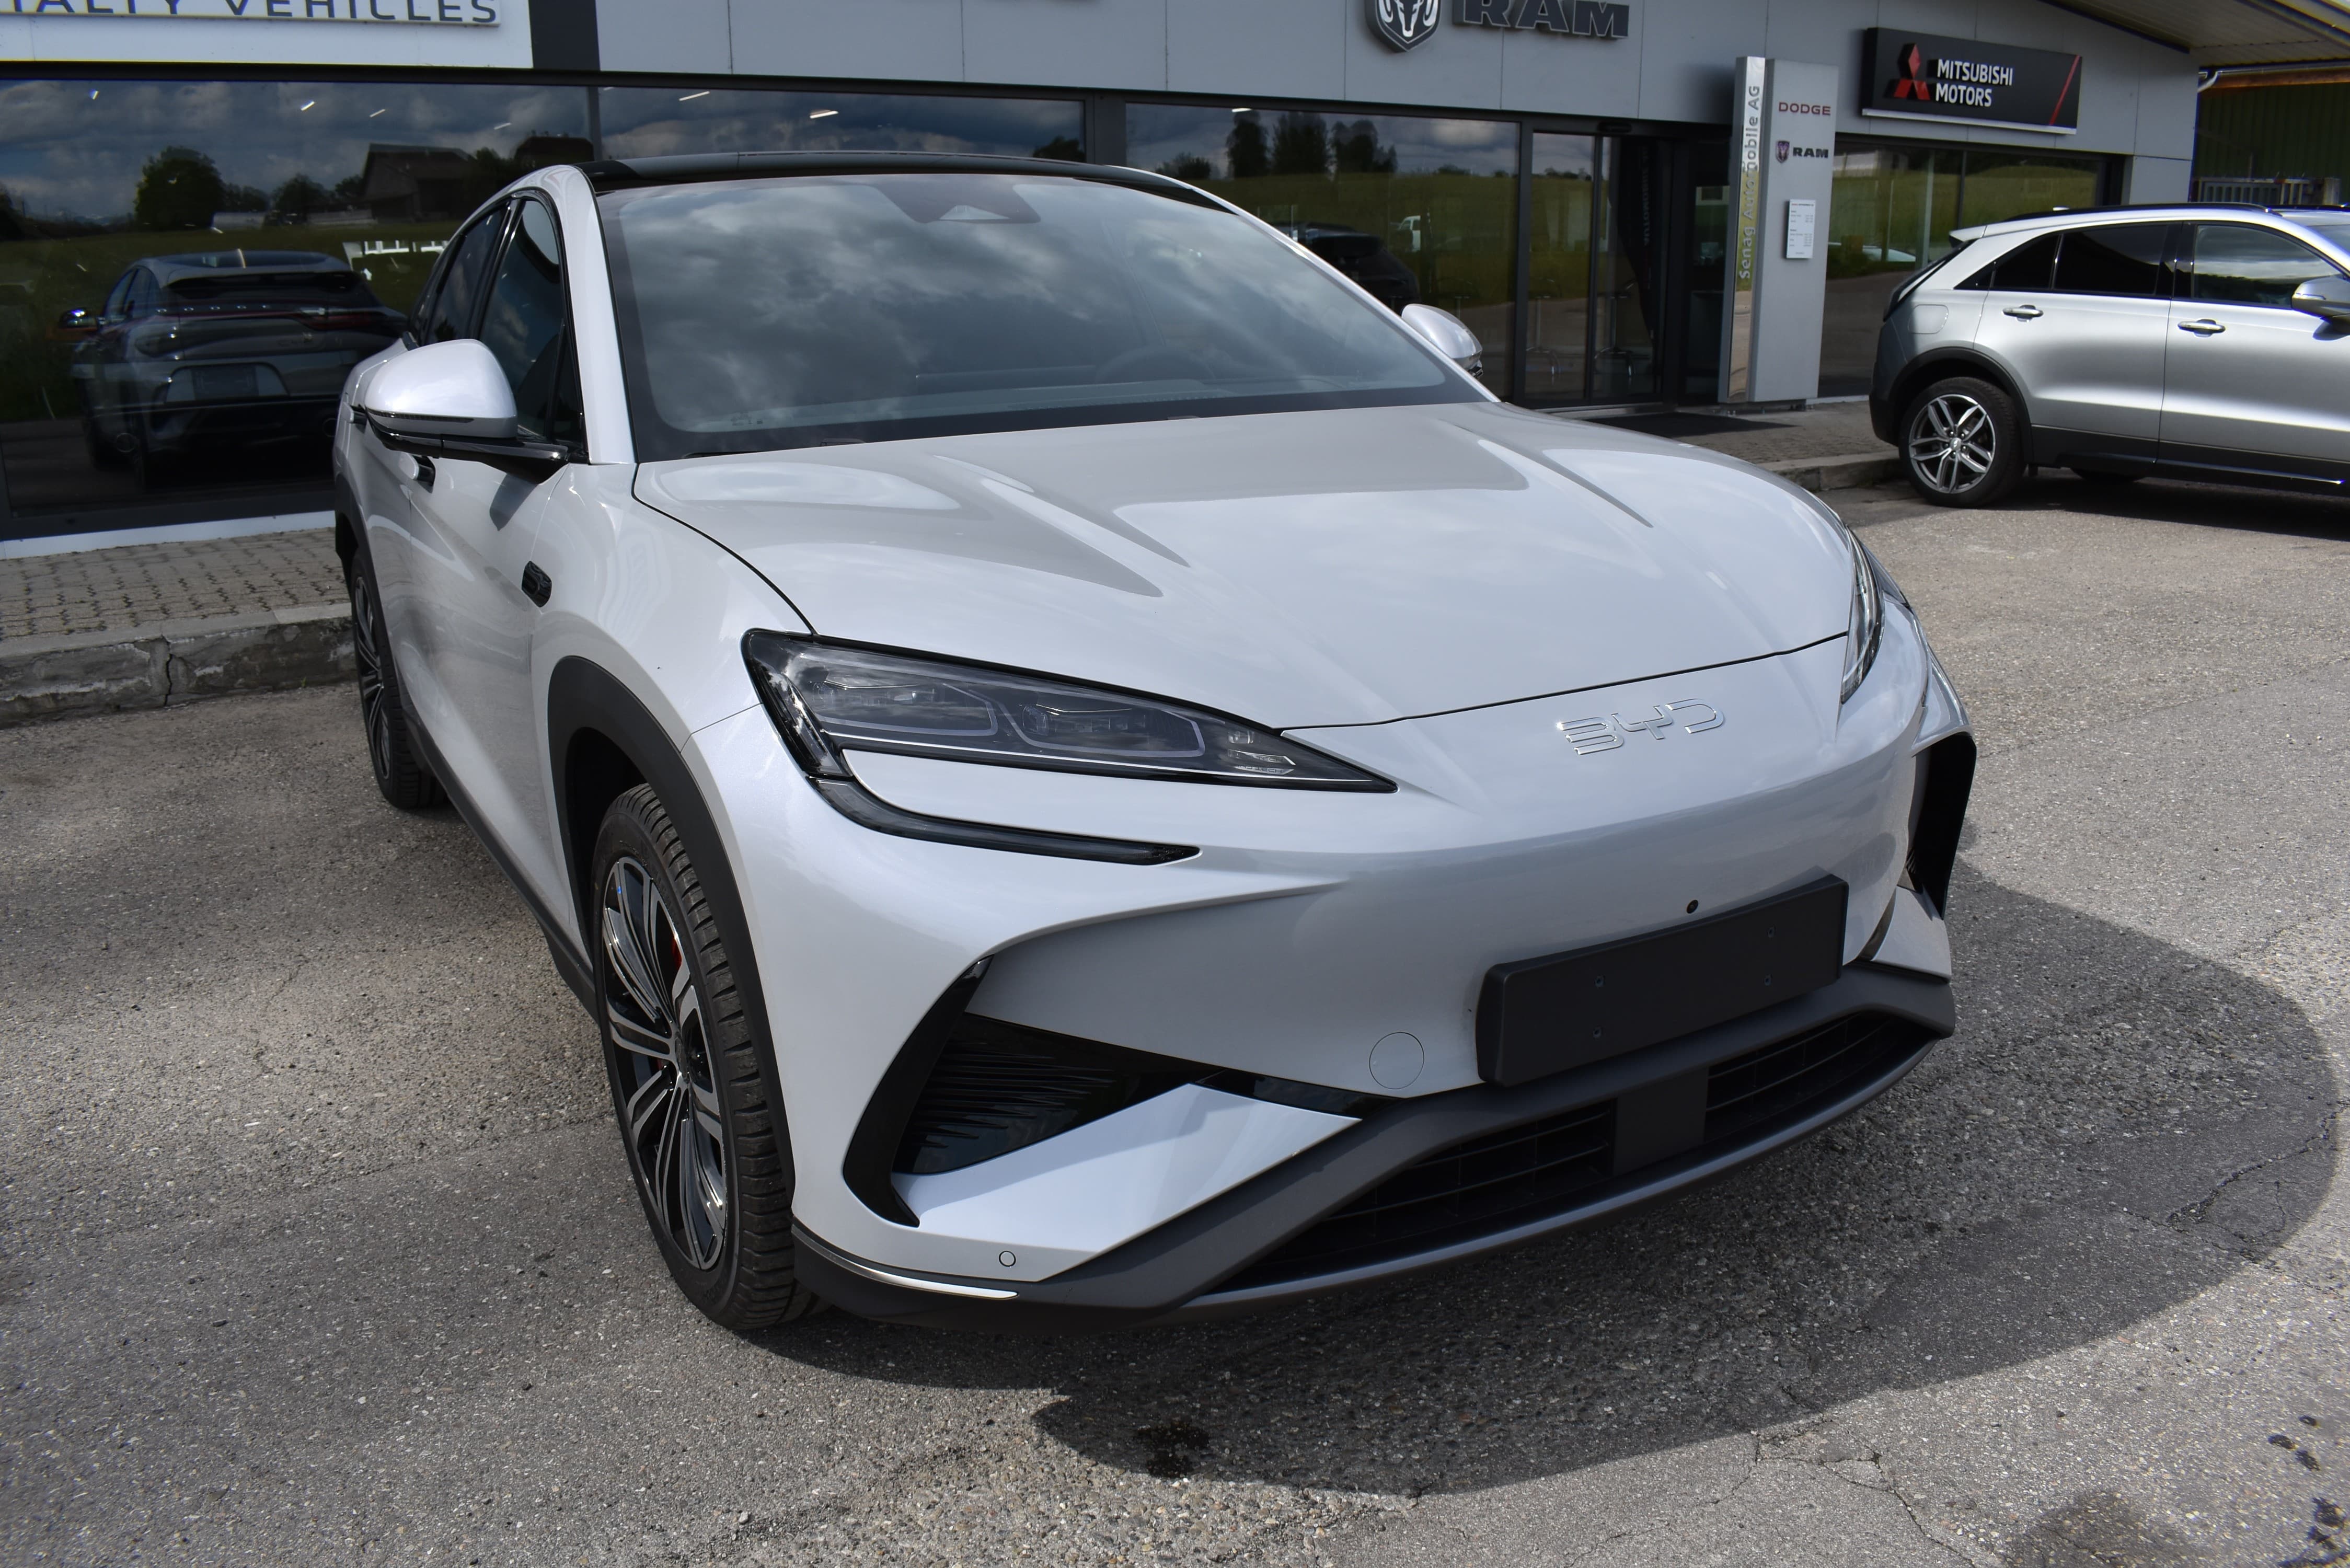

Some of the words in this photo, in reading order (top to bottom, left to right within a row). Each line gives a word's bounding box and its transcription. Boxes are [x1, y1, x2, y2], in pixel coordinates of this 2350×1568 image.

[225, 0, 497, 22] VEHICLES
[1464, 0, 1630, 38] RAM
[1937, 59, 2013, 86] MITSUBISHI
[1748, 86, 1760, 110] AG
[1936, 83, 1992, 107] MOTORS
[1779, 102, 1831, 116] DODGE
[1793, 147, 1829, 158] RAM
[1743, 116, 1758, 220] Automobile
[1739, 226, 1756, 279] Senag
[1556, 698, 1725, 755] BYD
